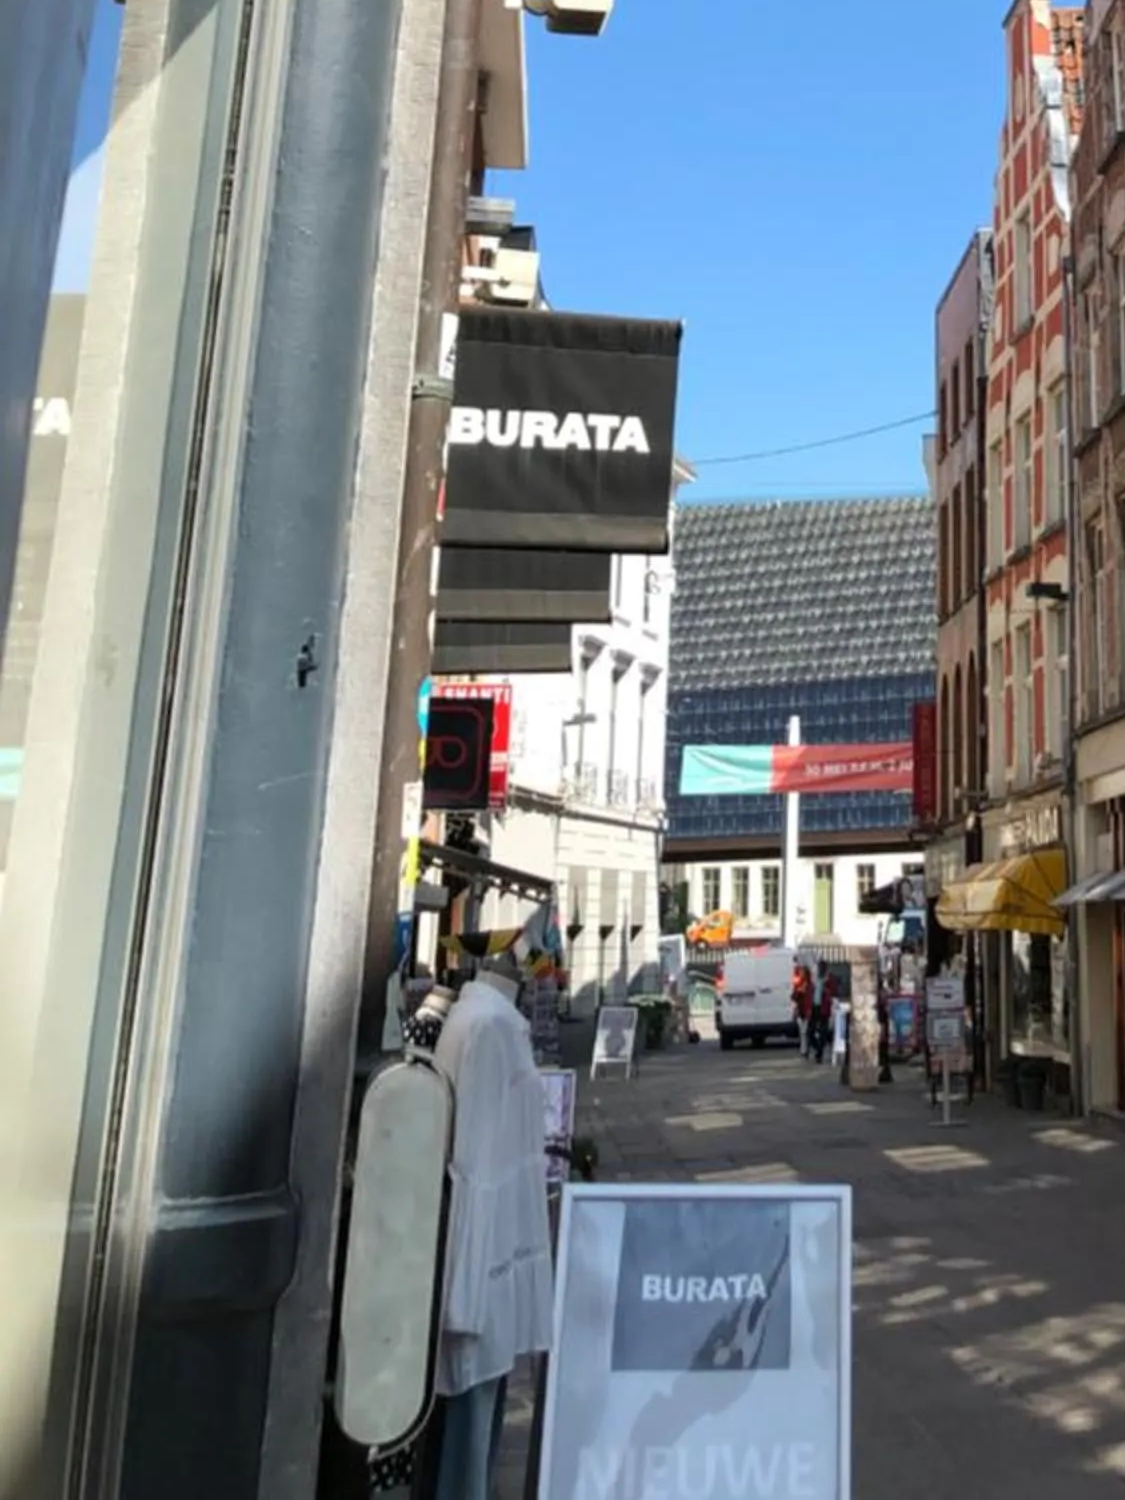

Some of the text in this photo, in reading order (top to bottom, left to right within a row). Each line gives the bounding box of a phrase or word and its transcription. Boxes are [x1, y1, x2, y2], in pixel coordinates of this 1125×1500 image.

[447, 406, 650, 454] BURATA
[641, 1273, 768, 1304] BURATA
[572, 1442, 819, 1500] NIEUWE
